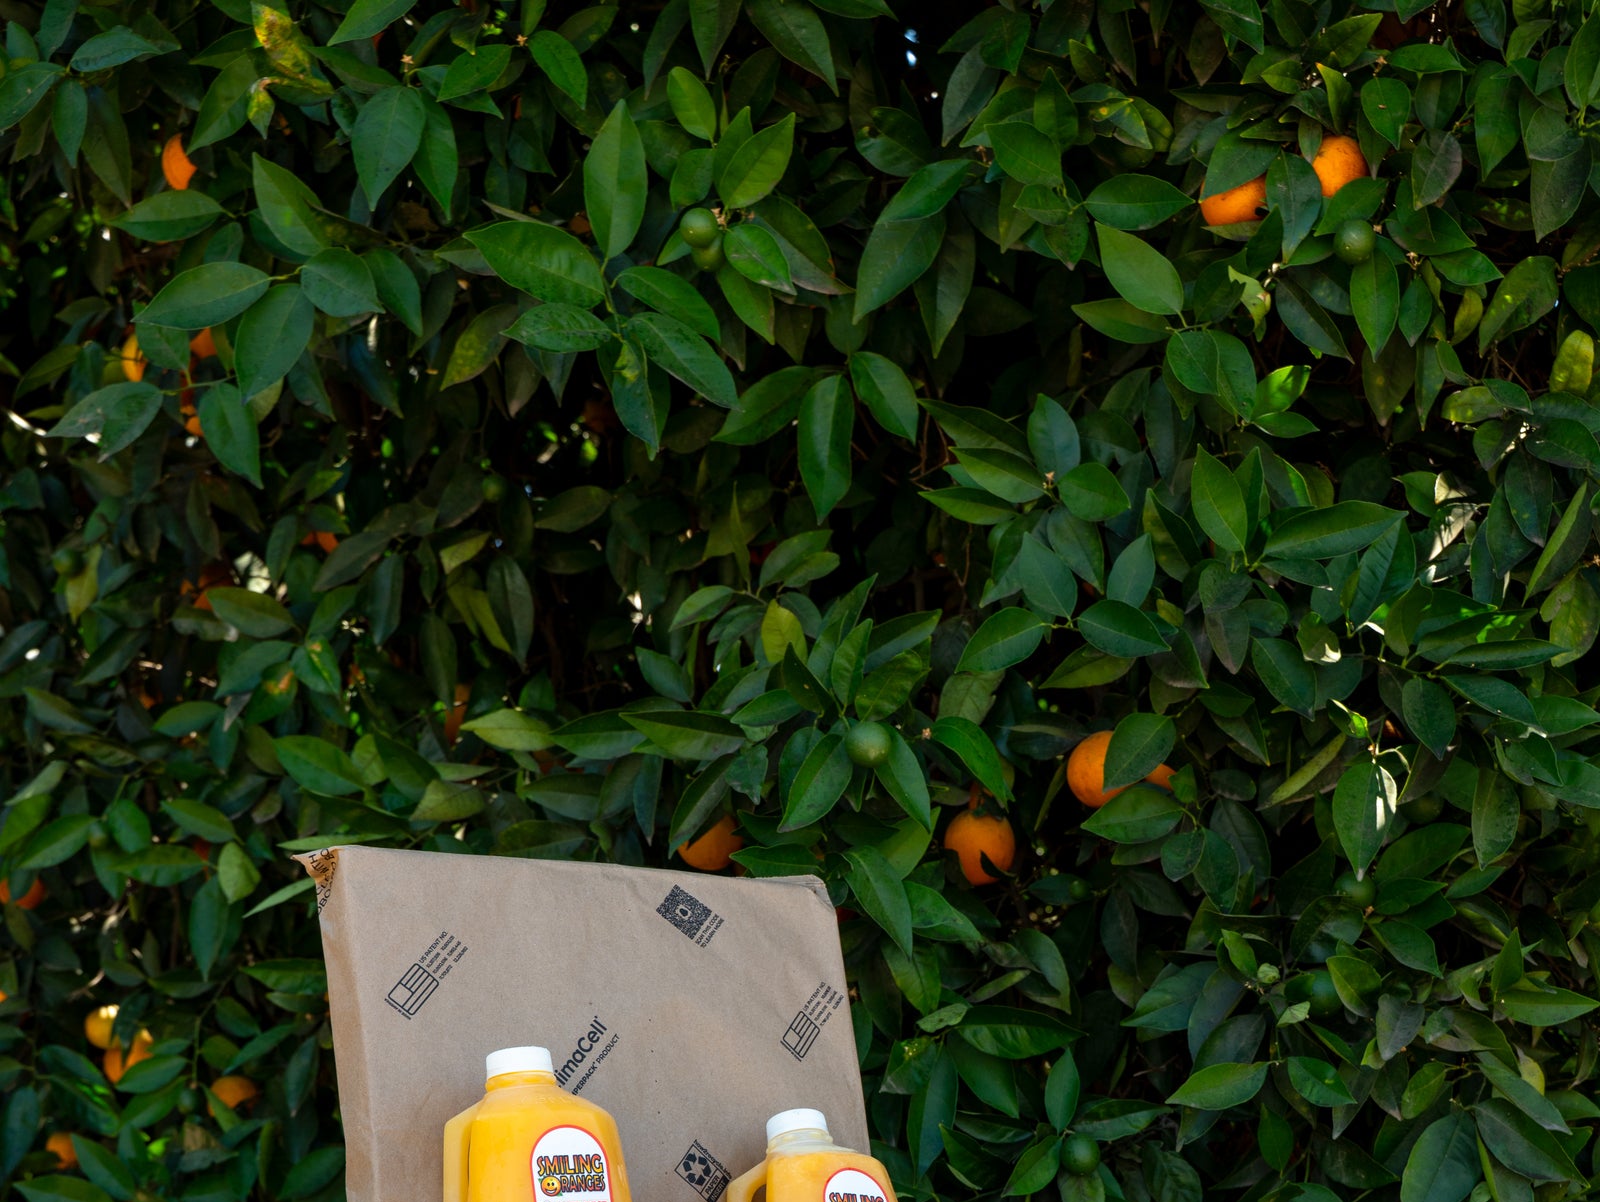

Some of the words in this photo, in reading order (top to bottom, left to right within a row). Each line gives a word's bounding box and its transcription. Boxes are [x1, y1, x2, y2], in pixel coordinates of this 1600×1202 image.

[419, 955, 428, 964] US
[425, 938, 441, 957] PATENT
[554, 1016, 607, 1088] limaCell
[596, 1033, 620, 1064] PRODUCT
[537, 1154, 604, 1176] SMILING
[705, 1175, 720, 1195] PAPER
